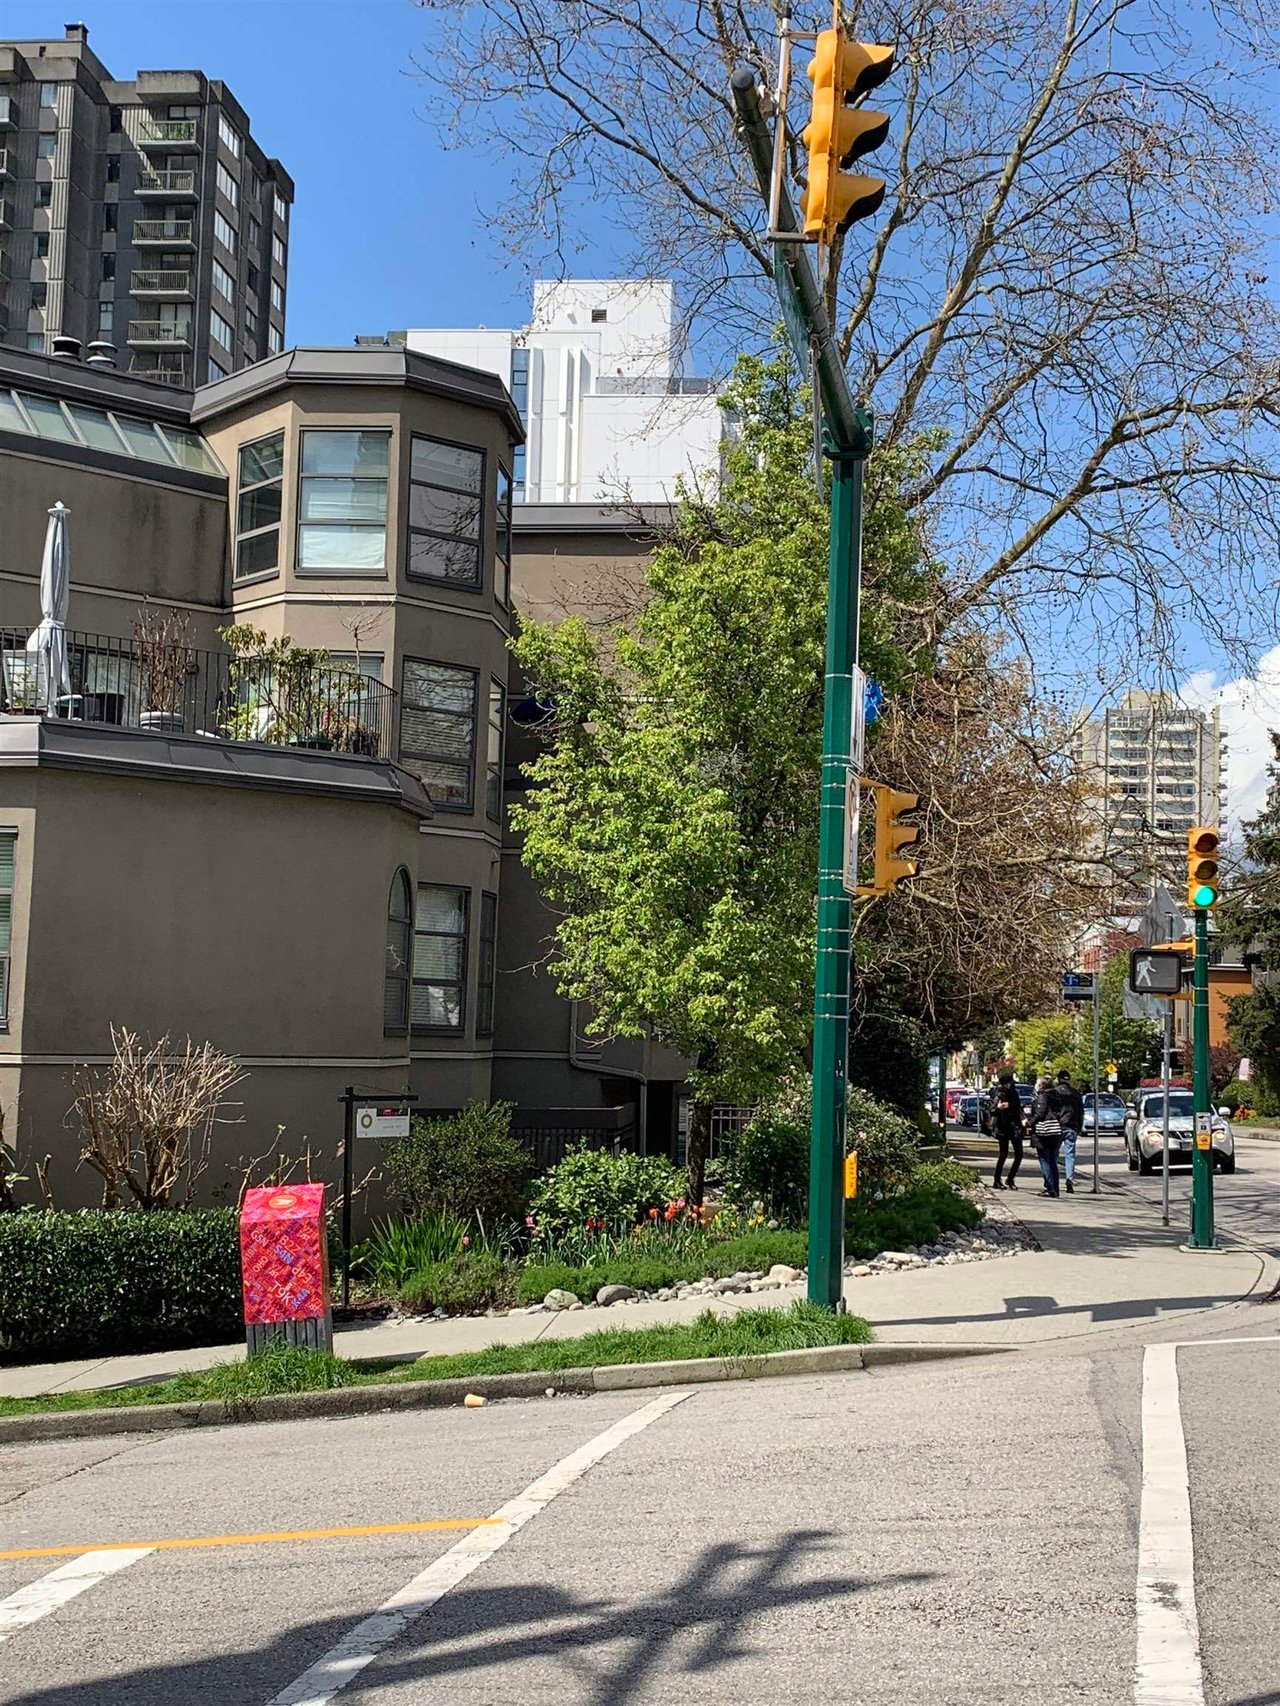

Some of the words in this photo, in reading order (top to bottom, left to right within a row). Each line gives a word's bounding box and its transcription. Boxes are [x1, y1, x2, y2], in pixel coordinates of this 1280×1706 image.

[280, 1235, 301, 1257] B2Z
[292, 1267, 312, 1284] E4P
[271, 1280, 294, 1306] T9K
